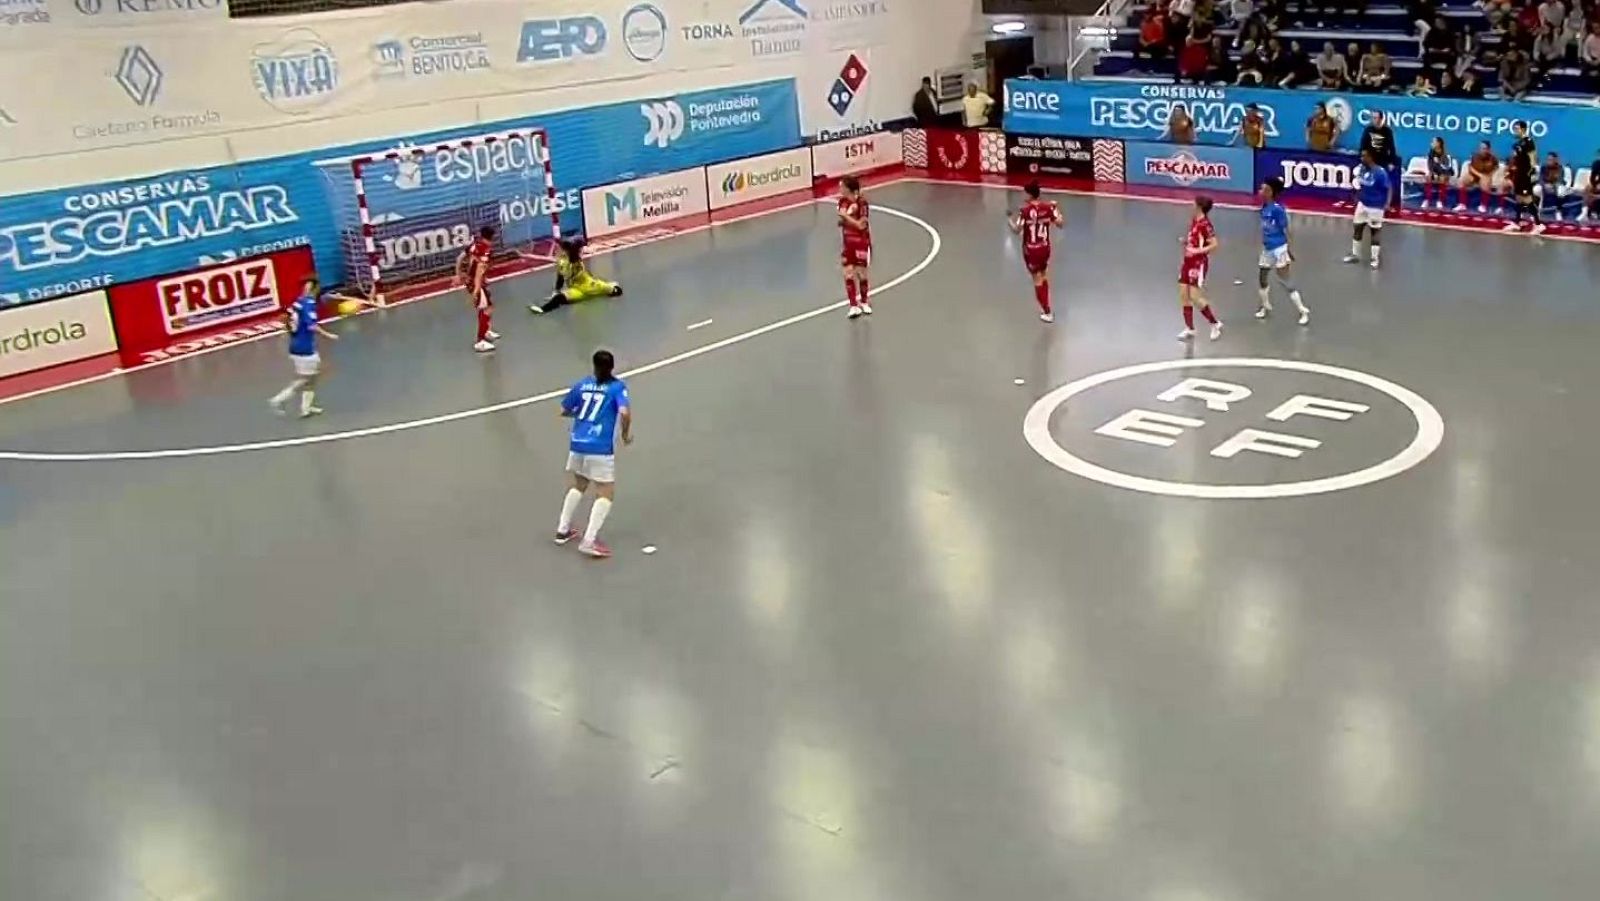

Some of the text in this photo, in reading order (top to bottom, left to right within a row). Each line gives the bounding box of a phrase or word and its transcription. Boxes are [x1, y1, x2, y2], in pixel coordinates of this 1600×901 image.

[681, 24, 733, 40] TORNA
[1012, 91, 1060, 111] ence
[1141, 85, 1225, 99] CONSERVAS
[690, 111, 760, 131] Pontevedra
[1466, 116, 1493, 134] DE
[747, 163, 801, 187] Iberdrola
[1147, 159, 1229, 178] PESCAMAR
[64, 176, 210, 212] CONSERVAS
[643, 204, 680, 218] Melilla
[1028, 223, 1048, 242] 14
[163, 265, 270, 316] FROIZ
[579, 391, 605, 422] 77
